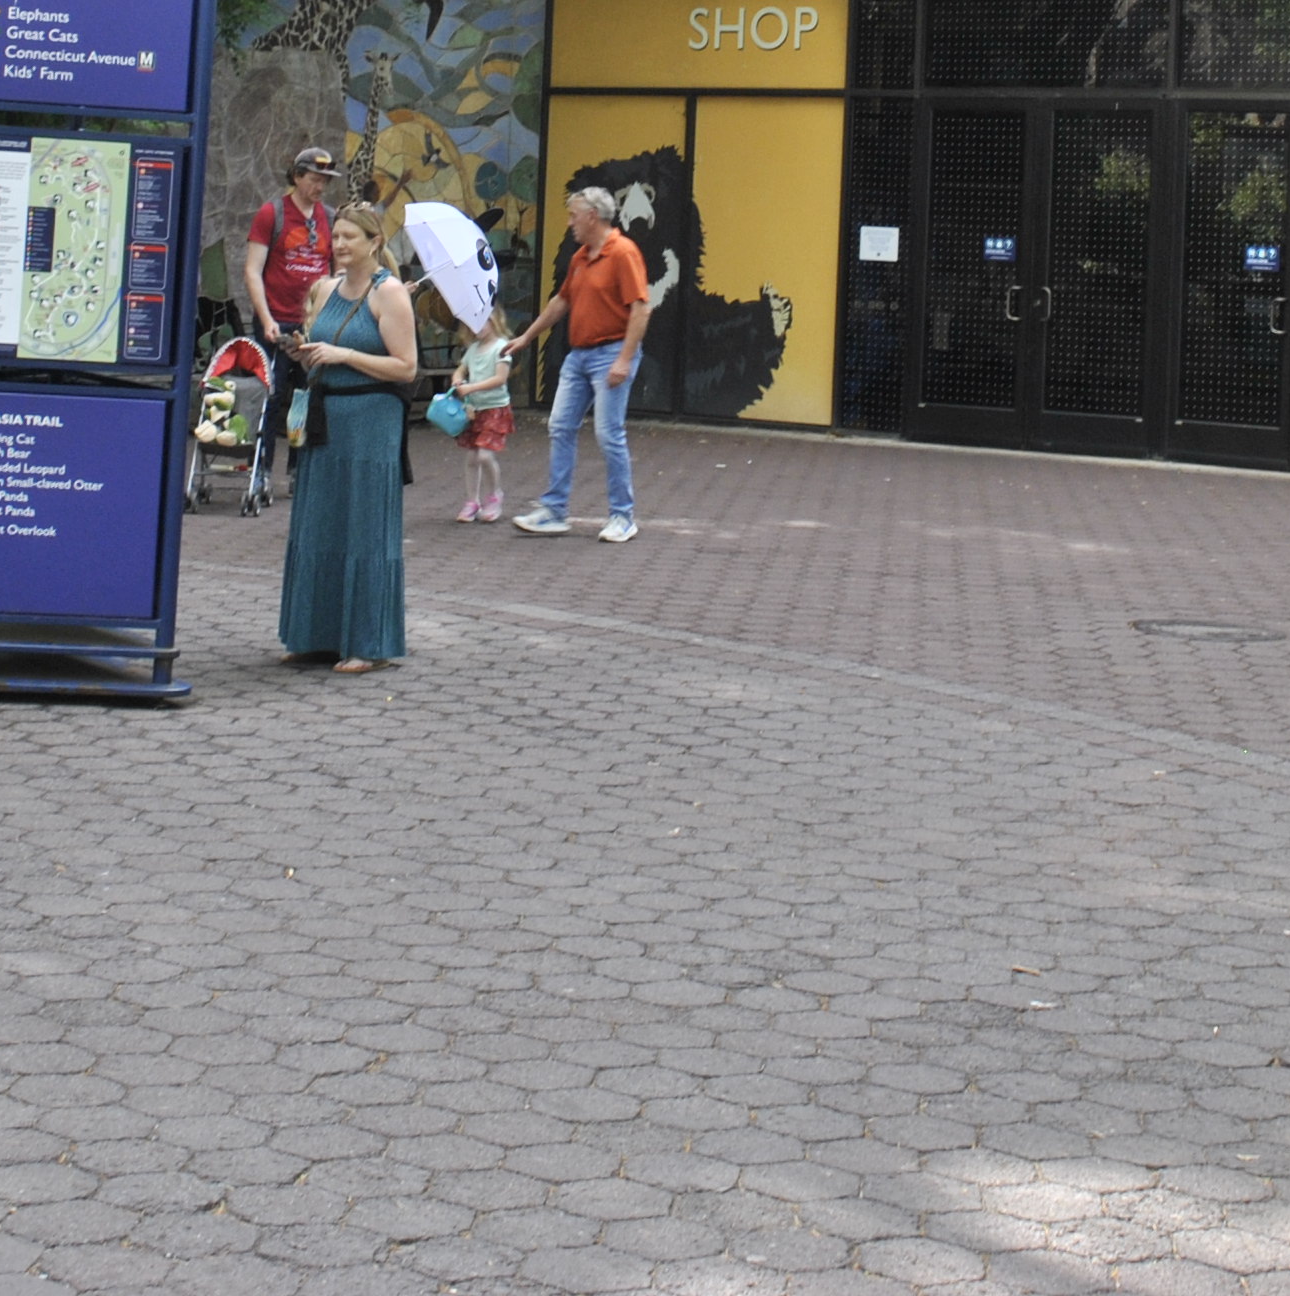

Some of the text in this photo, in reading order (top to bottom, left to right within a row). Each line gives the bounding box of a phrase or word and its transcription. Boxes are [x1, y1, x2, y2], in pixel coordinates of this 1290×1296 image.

[8, 6, 70, 24] Elephants
[6, 26, 79, 44] Great Cats
[688, 6, 819, 52] SHOP
[5, 45, 85, 64] Connecticut
[87, 51, 136, 66] Avenue
[3, 65, 74, 82] Kids' Farm
[24, 414, 64, 428] TRAIL
[16, 433, 36, 445] Cat
[7, 448, 31, 459] Bear
[23, 463, 66, 476] Leopard
[7, 476, 71, 490] Small-clawed
[73, 479, 104, 492] Otter
[5, 506, 36, 517] Panda
[7, 524, 57, 537] Overlook
